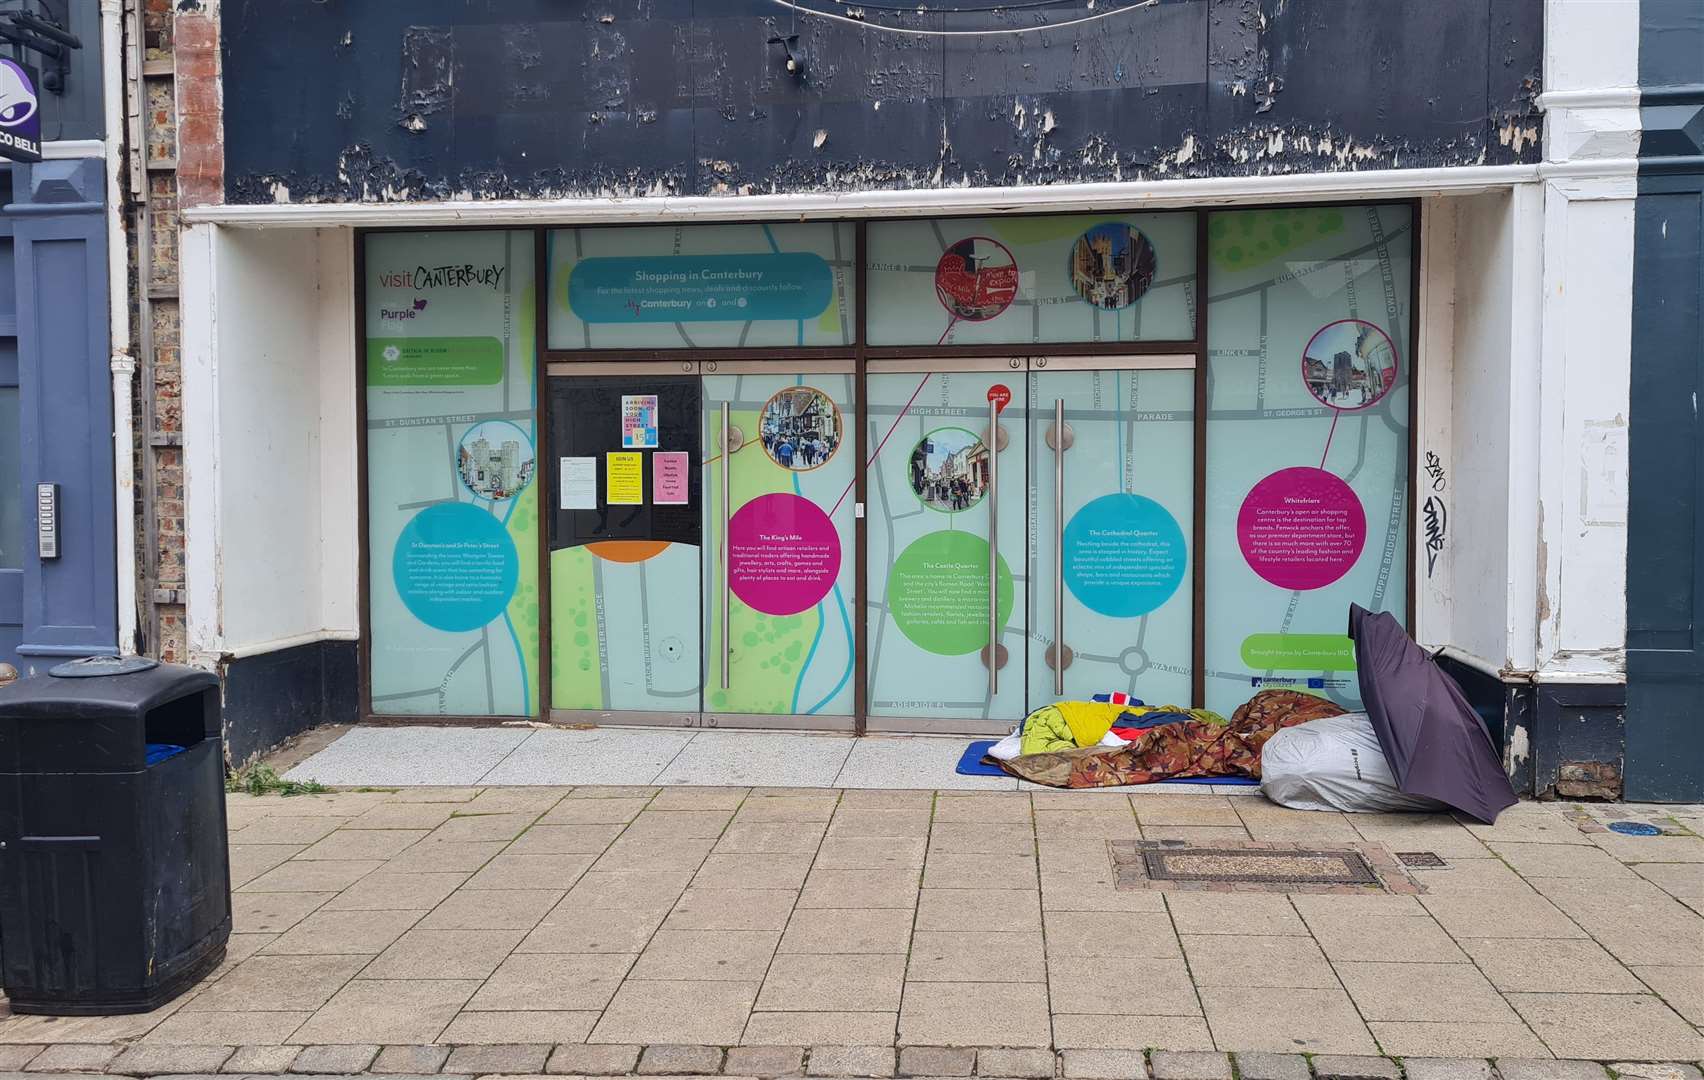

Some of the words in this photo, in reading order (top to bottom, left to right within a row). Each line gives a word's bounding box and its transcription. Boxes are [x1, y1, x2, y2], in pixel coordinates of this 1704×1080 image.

[14, 135, 40, 155] BELL
[379, 270, 413, 288] visit
[413, 264, 505, 290] CANTERBURY
[635, 271, 687, 282] Shopping
[689, 270, 698, 280] in
[702, 269, 763, 280] Canterbury
[641, 299, 691, 308] Canterbury
[380, 308, 416, 320] Purple
[911, 408, 932, 416] HIGH
[934, 408, 968, 416] STREET
[1137, 413, 1174, 421] PARADE
[1257, 508, 1294, 516] Canterbury's
[1295, 508, 1309, 516] open
[1320, 508, 1347, 516] shopping
[1375, 567, 1389, 599] UPPER
[1384, 528, 1397, 563] BRIDGE
[1391, 488, 1402, 525] STREET
